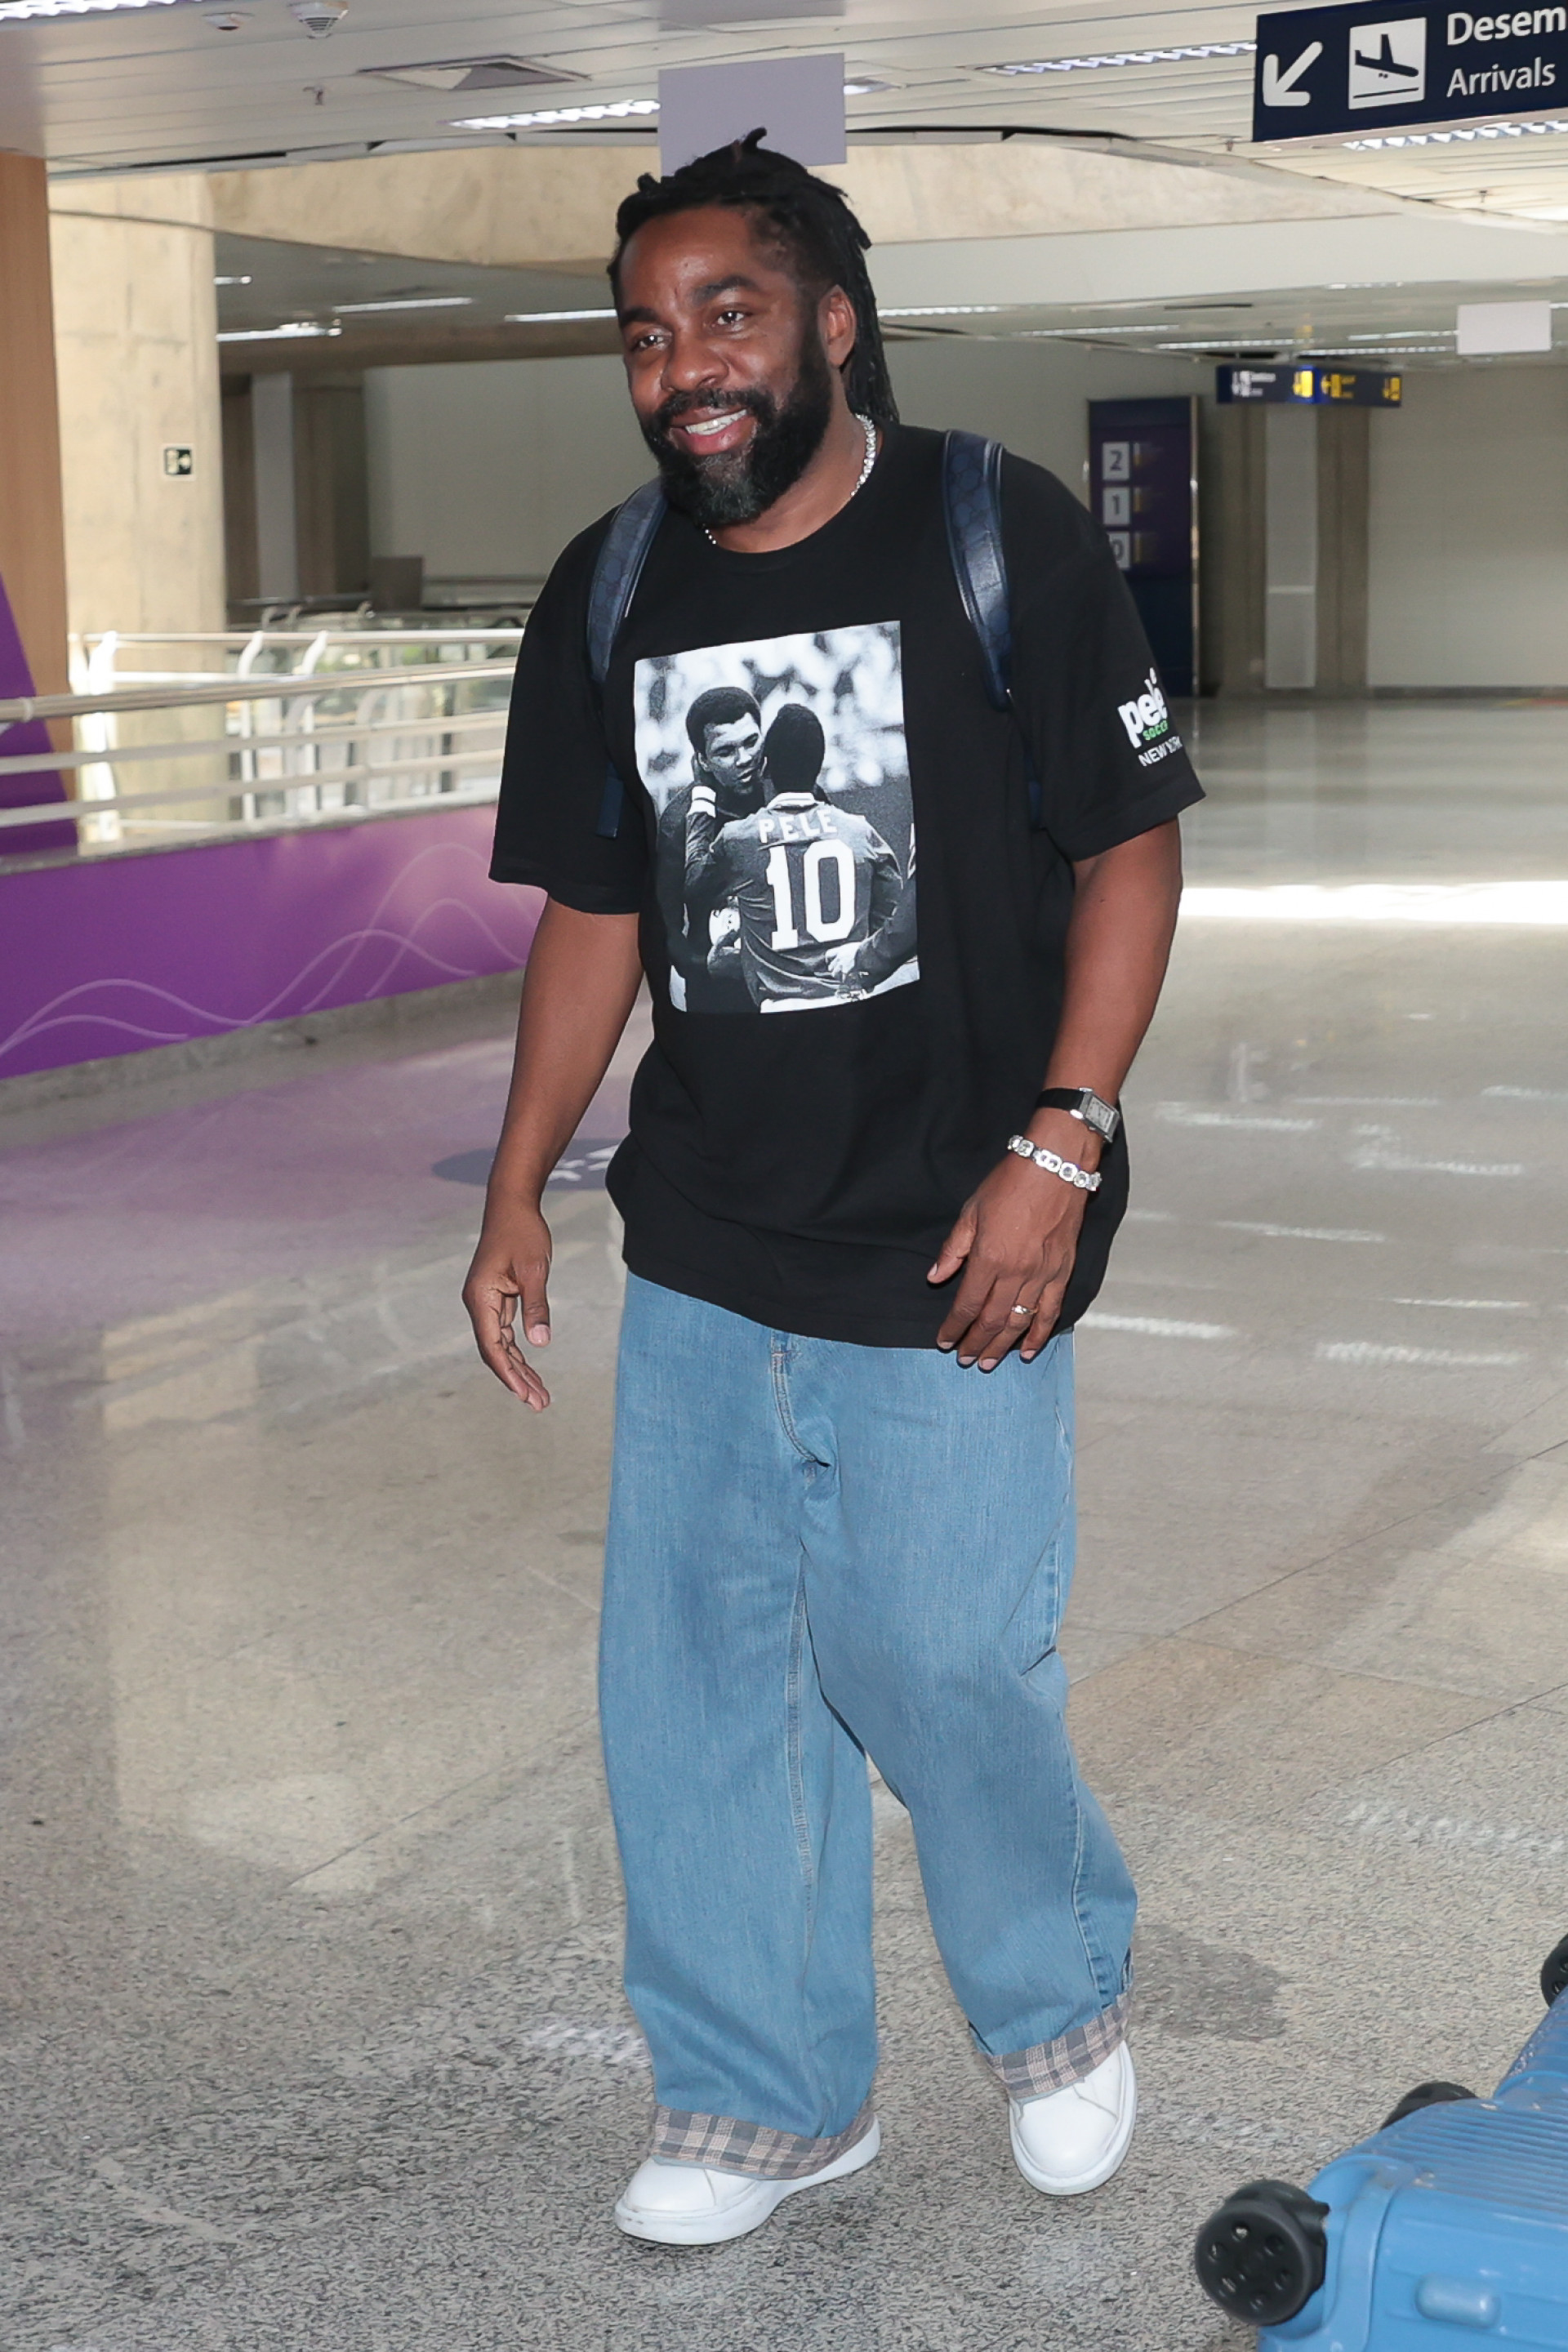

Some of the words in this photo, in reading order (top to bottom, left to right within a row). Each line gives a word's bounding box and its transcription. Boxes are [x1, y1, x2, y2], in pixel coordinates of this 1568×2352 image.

[1446, 7, 1567, 46] Desem
[1446, 56, 1557, 98] Arrivals
[1110, 450, 1124, 471] 2
[1111, 493, 1120, 516] 1
[758, 808, 838, 844] PELE
[766, 839, 856, 951] 10
